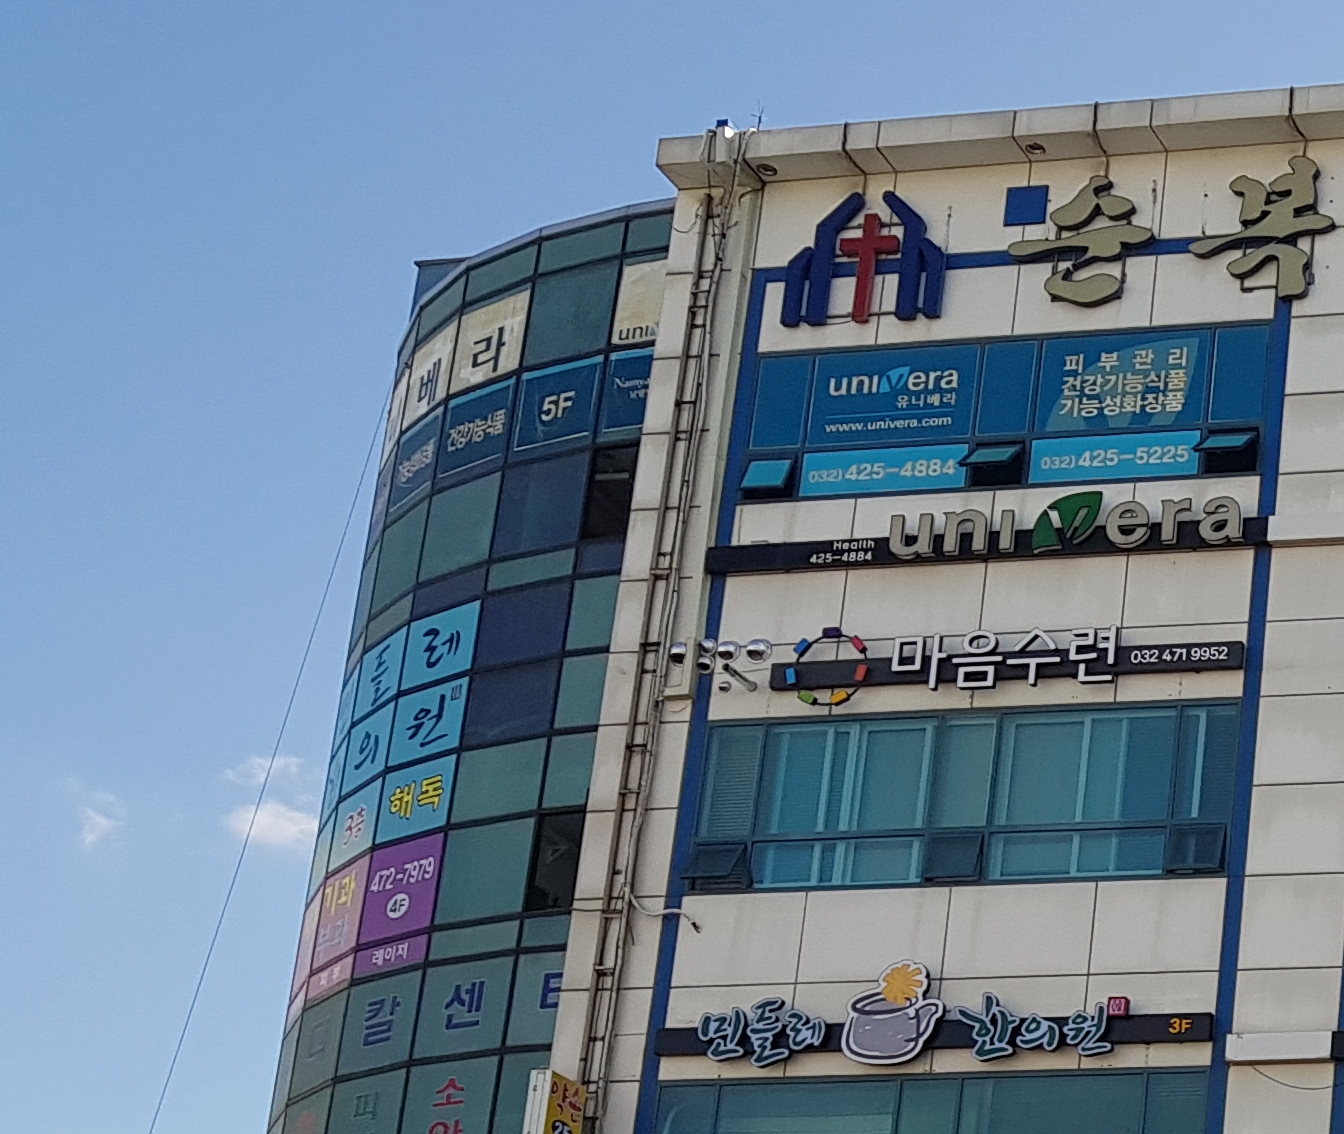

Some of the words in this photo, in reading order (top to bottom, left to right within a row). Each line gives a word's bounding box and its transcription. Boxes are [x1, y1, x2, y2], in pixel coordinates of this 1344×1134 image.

[829, 366, 959, 396] univera
[1061, 369, 1189, 397] 건강기능식품
[540, 391, 576, 422] 5F
[896, 391, 957, 409] 유니베라
[1059, 392, 1186, 418] 기능성화장품
[825, 414, 952, 434] www.univera.com
[888, 491, 1244, 560] univera
[809, 550, 873, 564] 425-4884
[832, 538, 876, 551] Health
[890, 624, 1119, 690] 마음수련
[1129, 644, 1160, 664] 032
[1161, 644, 1188, 664] 471
[1189, 645, 1229, 664] 9952
[369, 856, 436, 894] 472-7979
[955, 991, 1114, 1062] 한의원
[1167, 1016, 1192, 1035] 3F
